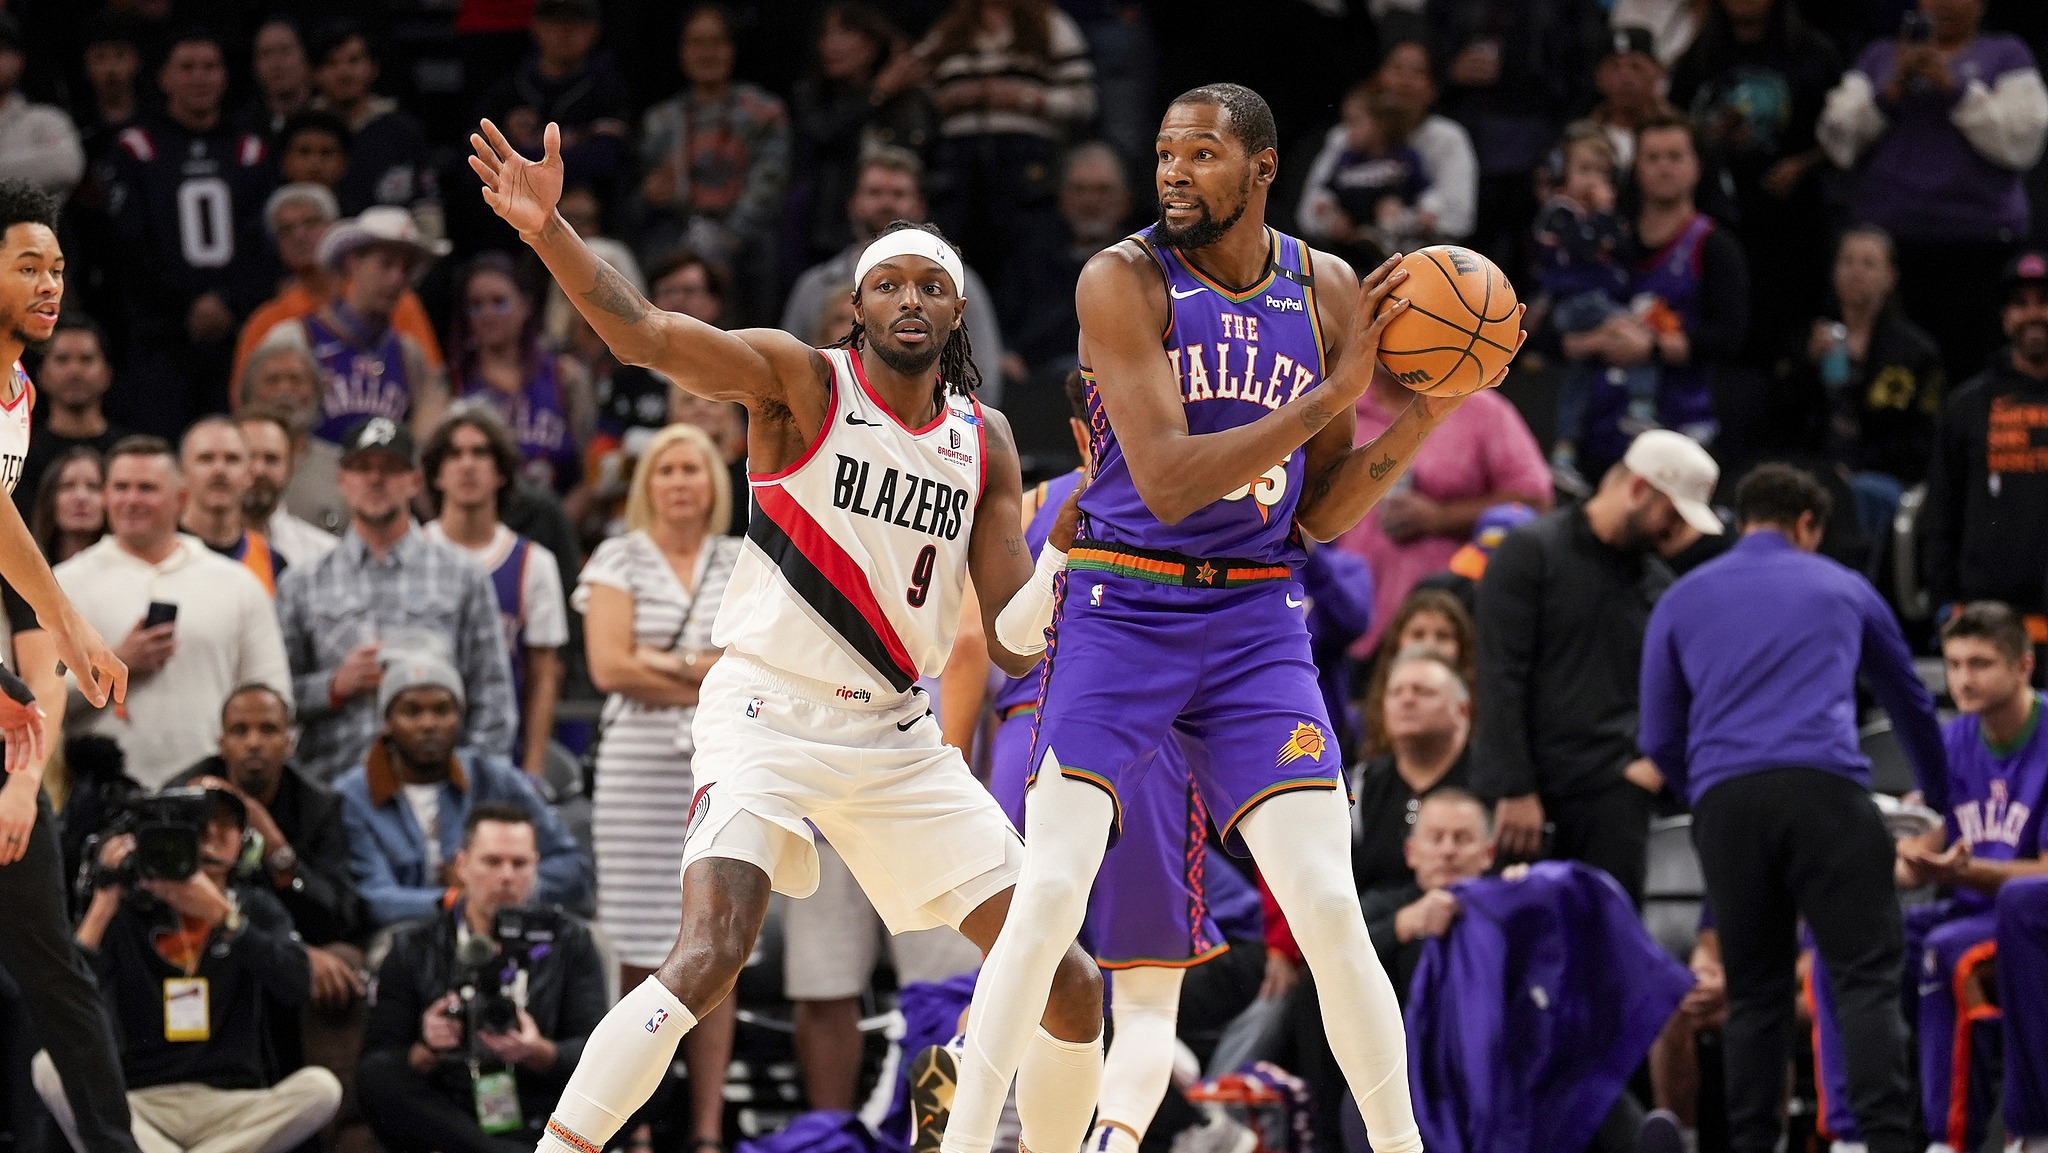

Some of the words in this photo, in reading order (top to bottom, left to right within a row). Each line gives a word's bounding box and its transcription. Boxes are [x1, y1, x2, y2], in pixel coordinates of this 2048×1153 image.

[1285, 270, 1294, 280] AL
[1266, 295, 1303, 312] PayPal
[1221, 313, 1259, 341] THE
[937, 446, 973, 464] BRIGHTSIDE
[1221, 453, 1292, 506] 5
[833, 453, 969, 541] BLAZERS
[906, 544, 937, 609] 9
[836, 685, 872, 703] ripcity
